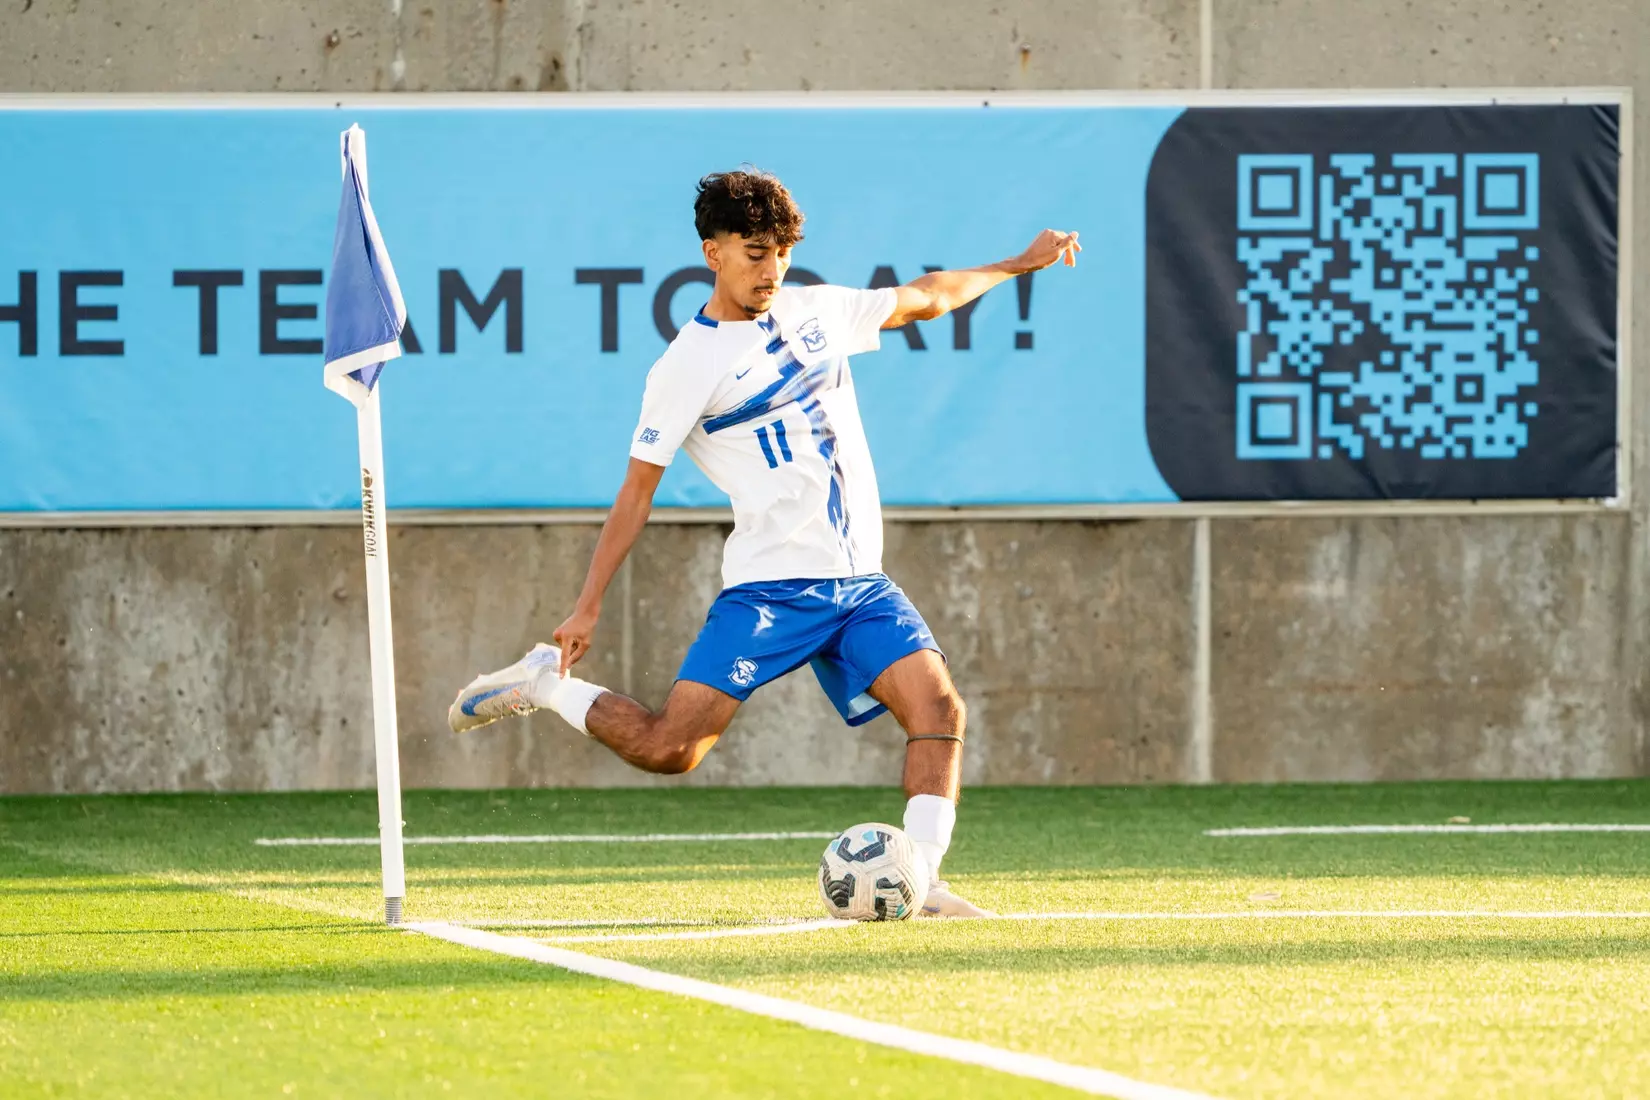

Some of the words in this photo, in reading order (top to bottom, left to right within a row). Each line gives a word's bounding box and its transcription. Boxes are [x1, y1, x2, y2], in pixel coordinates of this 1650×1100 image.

[173, 268, 524, 355] TEM
[575, 265, 1034, 352] TOAY!
[643, 427, 660, 438] BIG
[753, 419, 793, 469] 11
